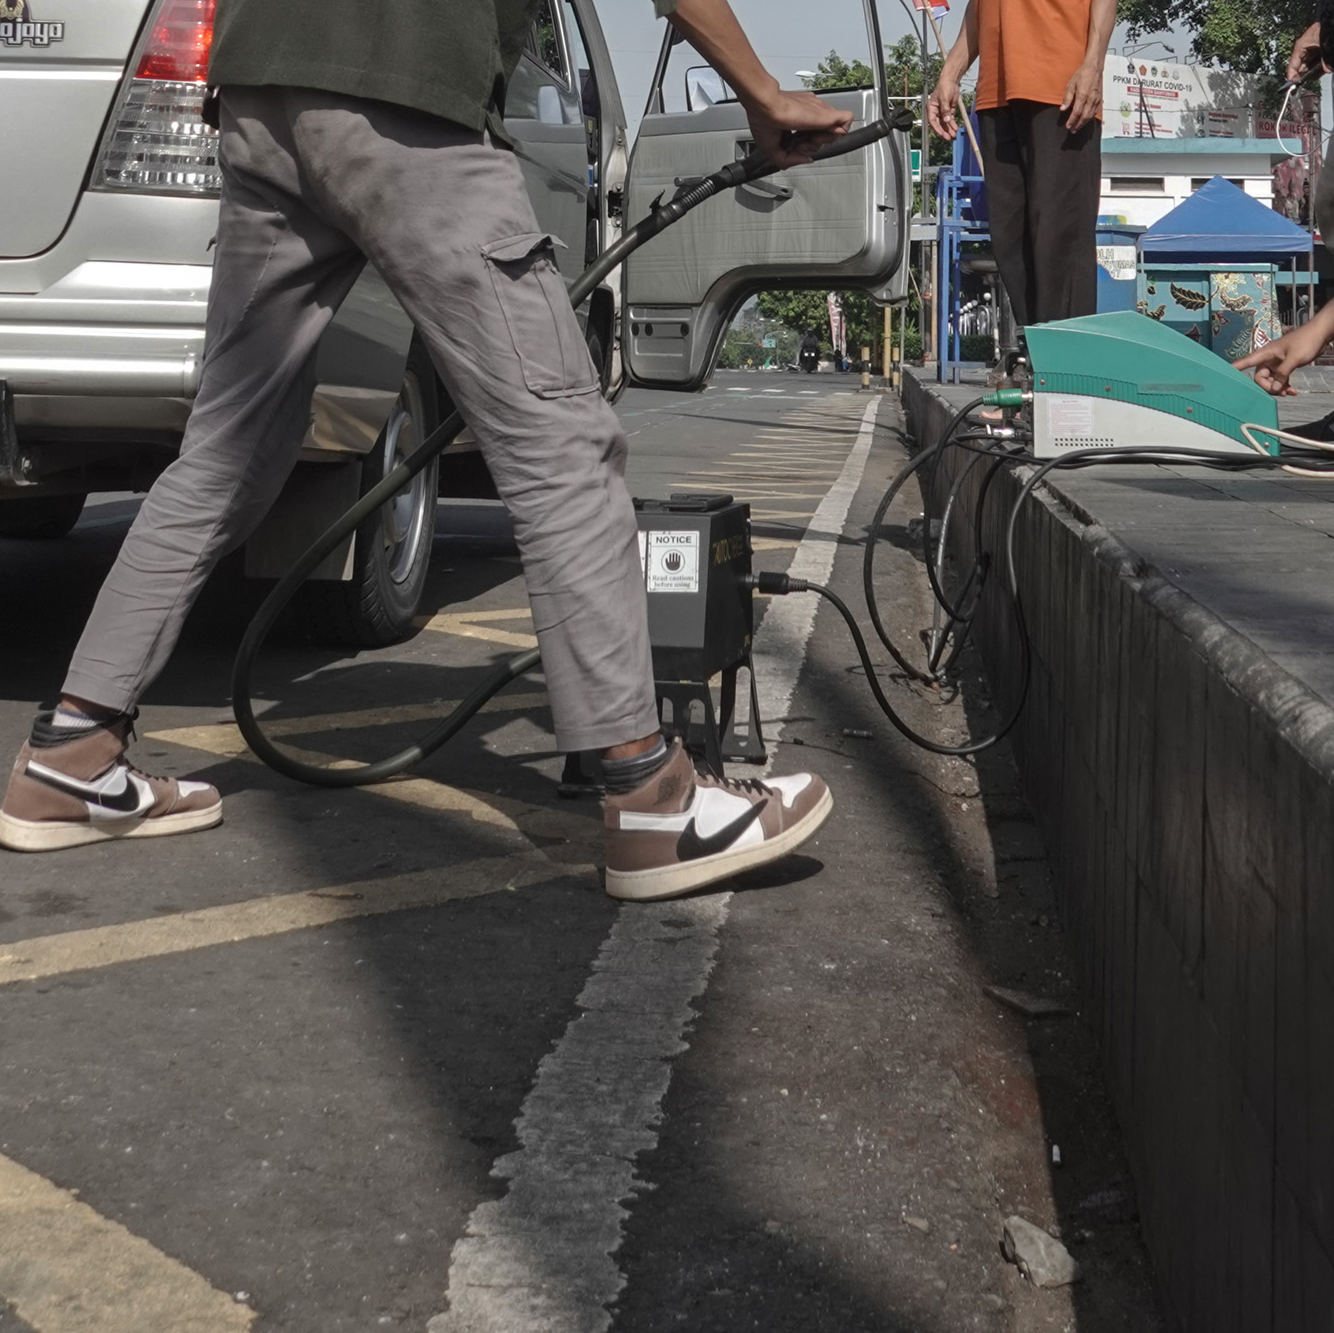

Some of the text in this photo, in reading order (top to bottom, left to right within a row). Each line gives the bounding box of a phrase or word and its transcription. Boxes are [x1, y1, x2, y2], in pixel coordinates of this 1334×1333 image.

[1113, 75, 1132, 85] PPKM
[1164, 82, 1193, 93] COVID-19
[655, 535, 692, 544] NOTICE
